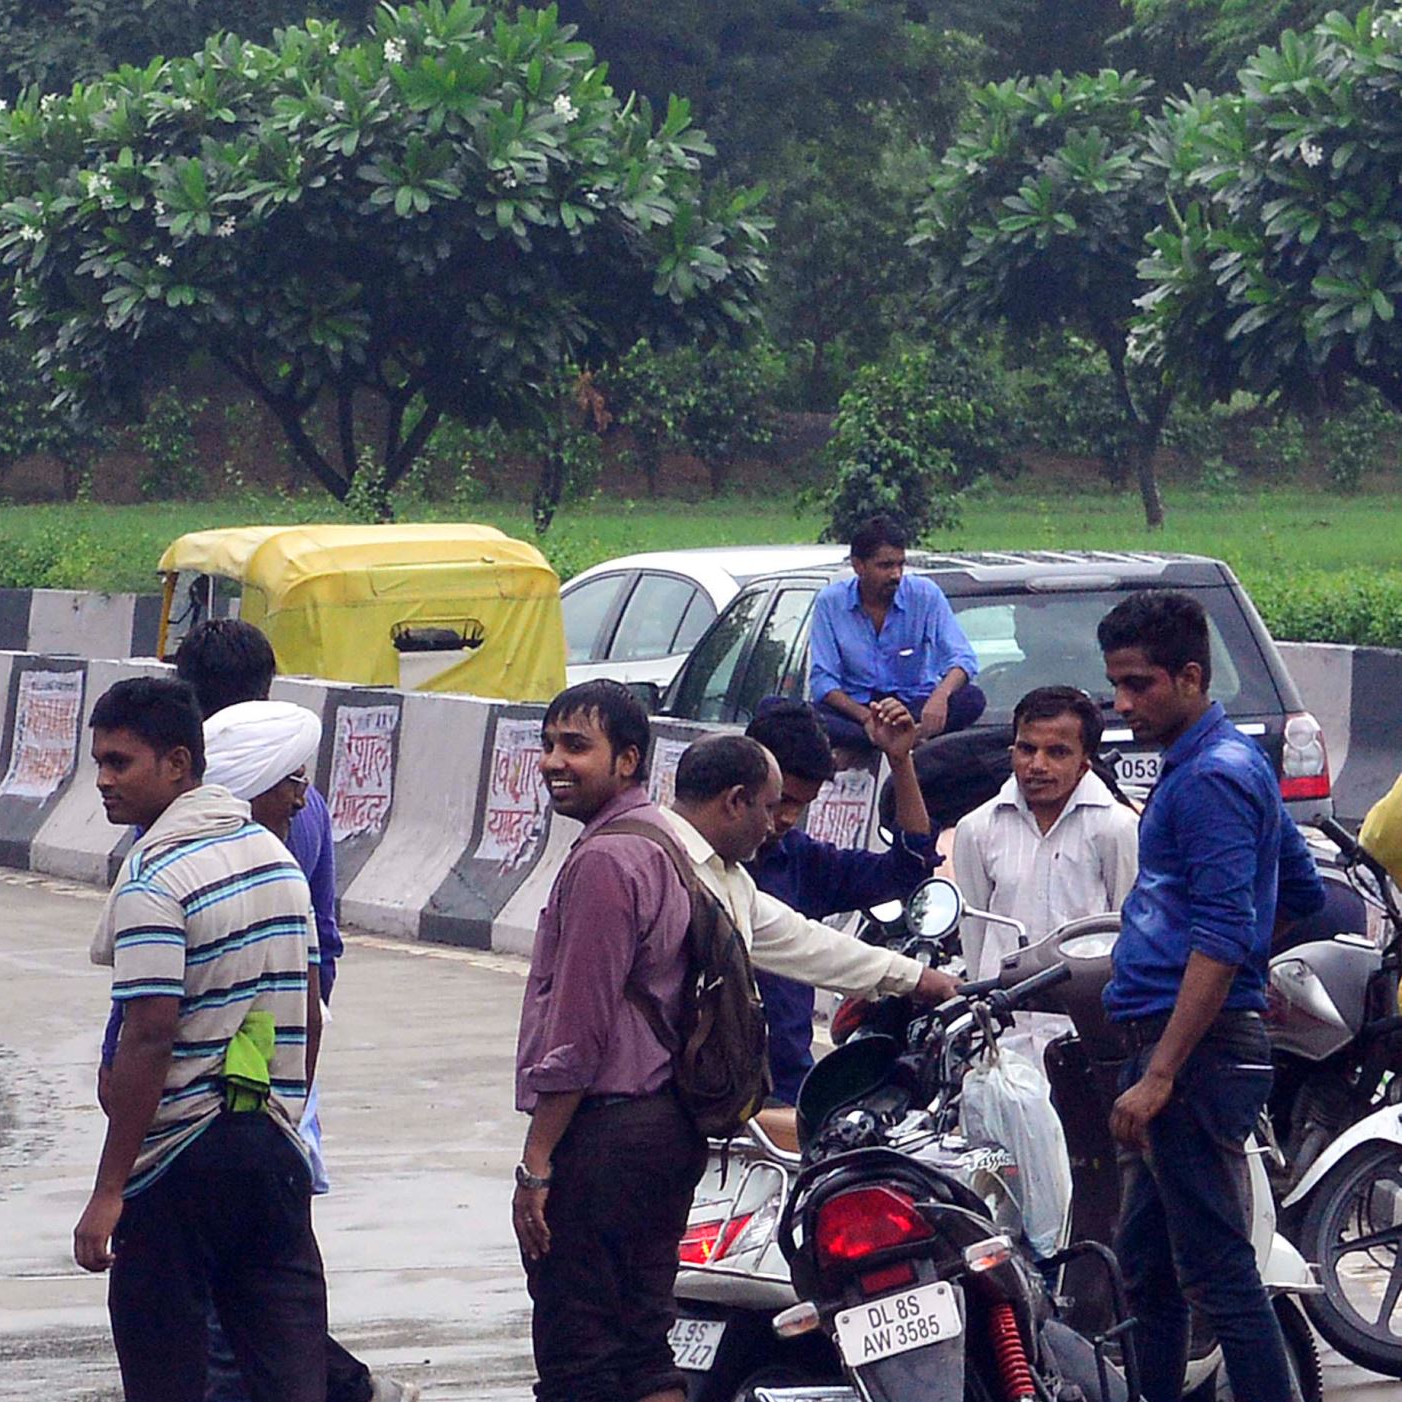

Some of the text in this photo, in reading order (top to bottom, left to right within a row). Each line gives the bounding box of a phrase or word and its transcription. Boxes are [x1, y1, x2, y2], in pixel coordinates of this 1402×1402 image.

[867, 1295, 920, 1329] DL 8S
[863, 1314, 940, 1357] AW 3585
[672, 1343, 713, 1366] 747
